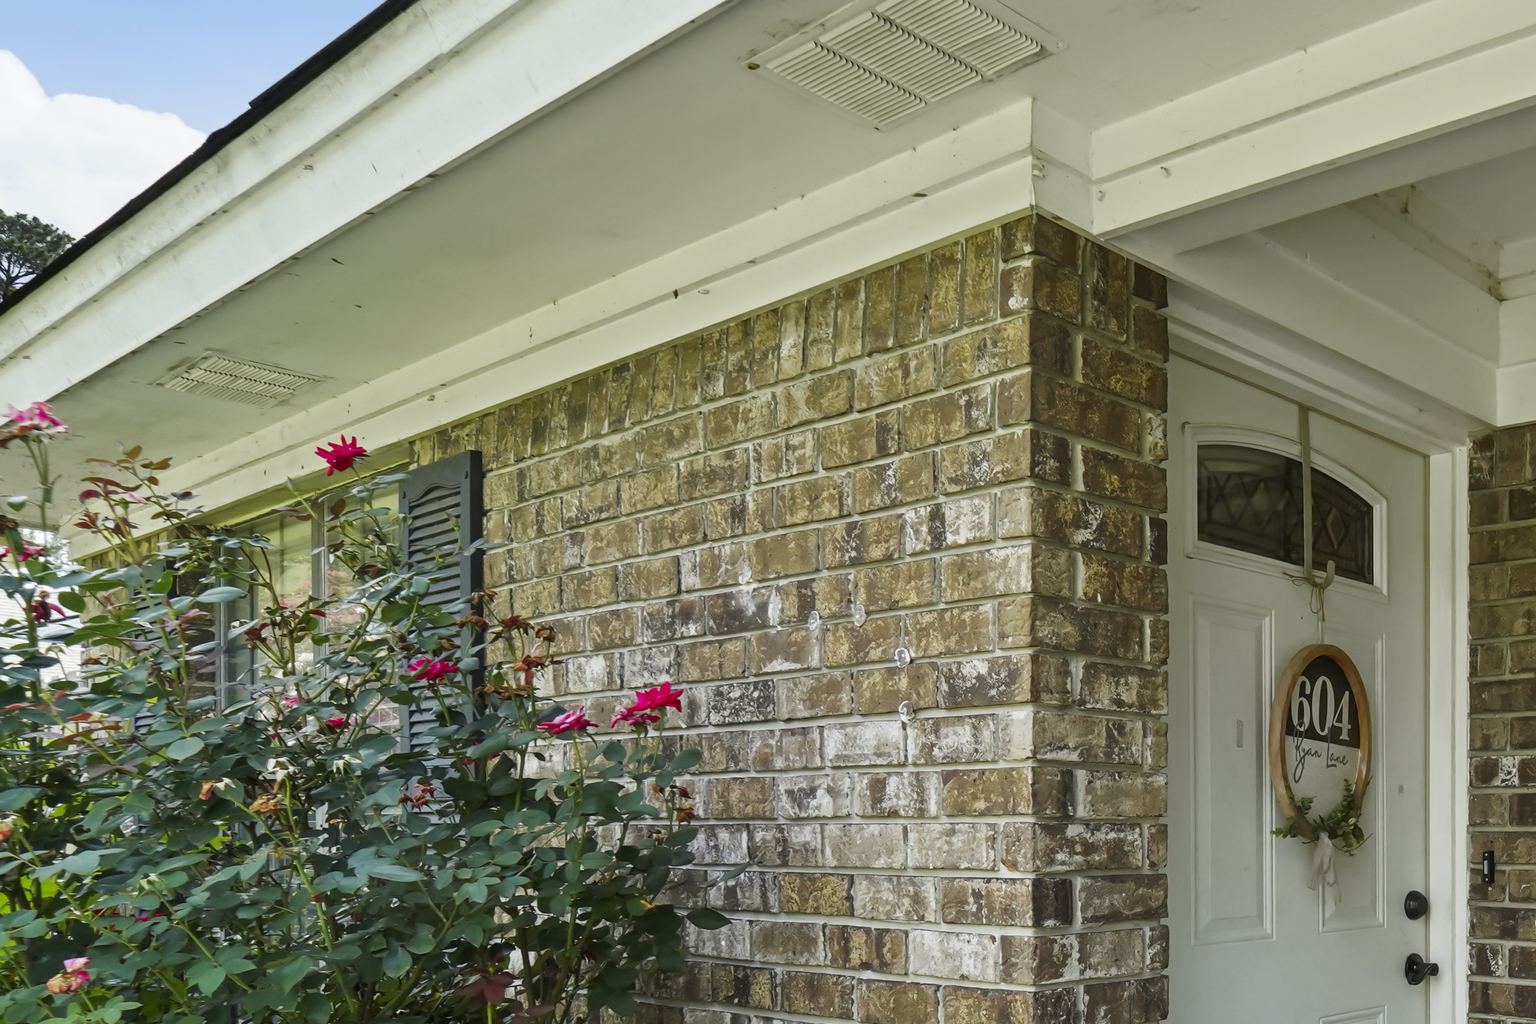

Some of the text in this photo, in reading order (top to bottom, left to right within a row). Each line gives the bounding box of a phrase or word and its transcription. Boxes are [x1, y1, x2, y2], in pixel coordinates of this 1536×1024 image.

[1291, 675, 1351, 740] 604
[1292, 718, 1349, 784] Ryan Lane
